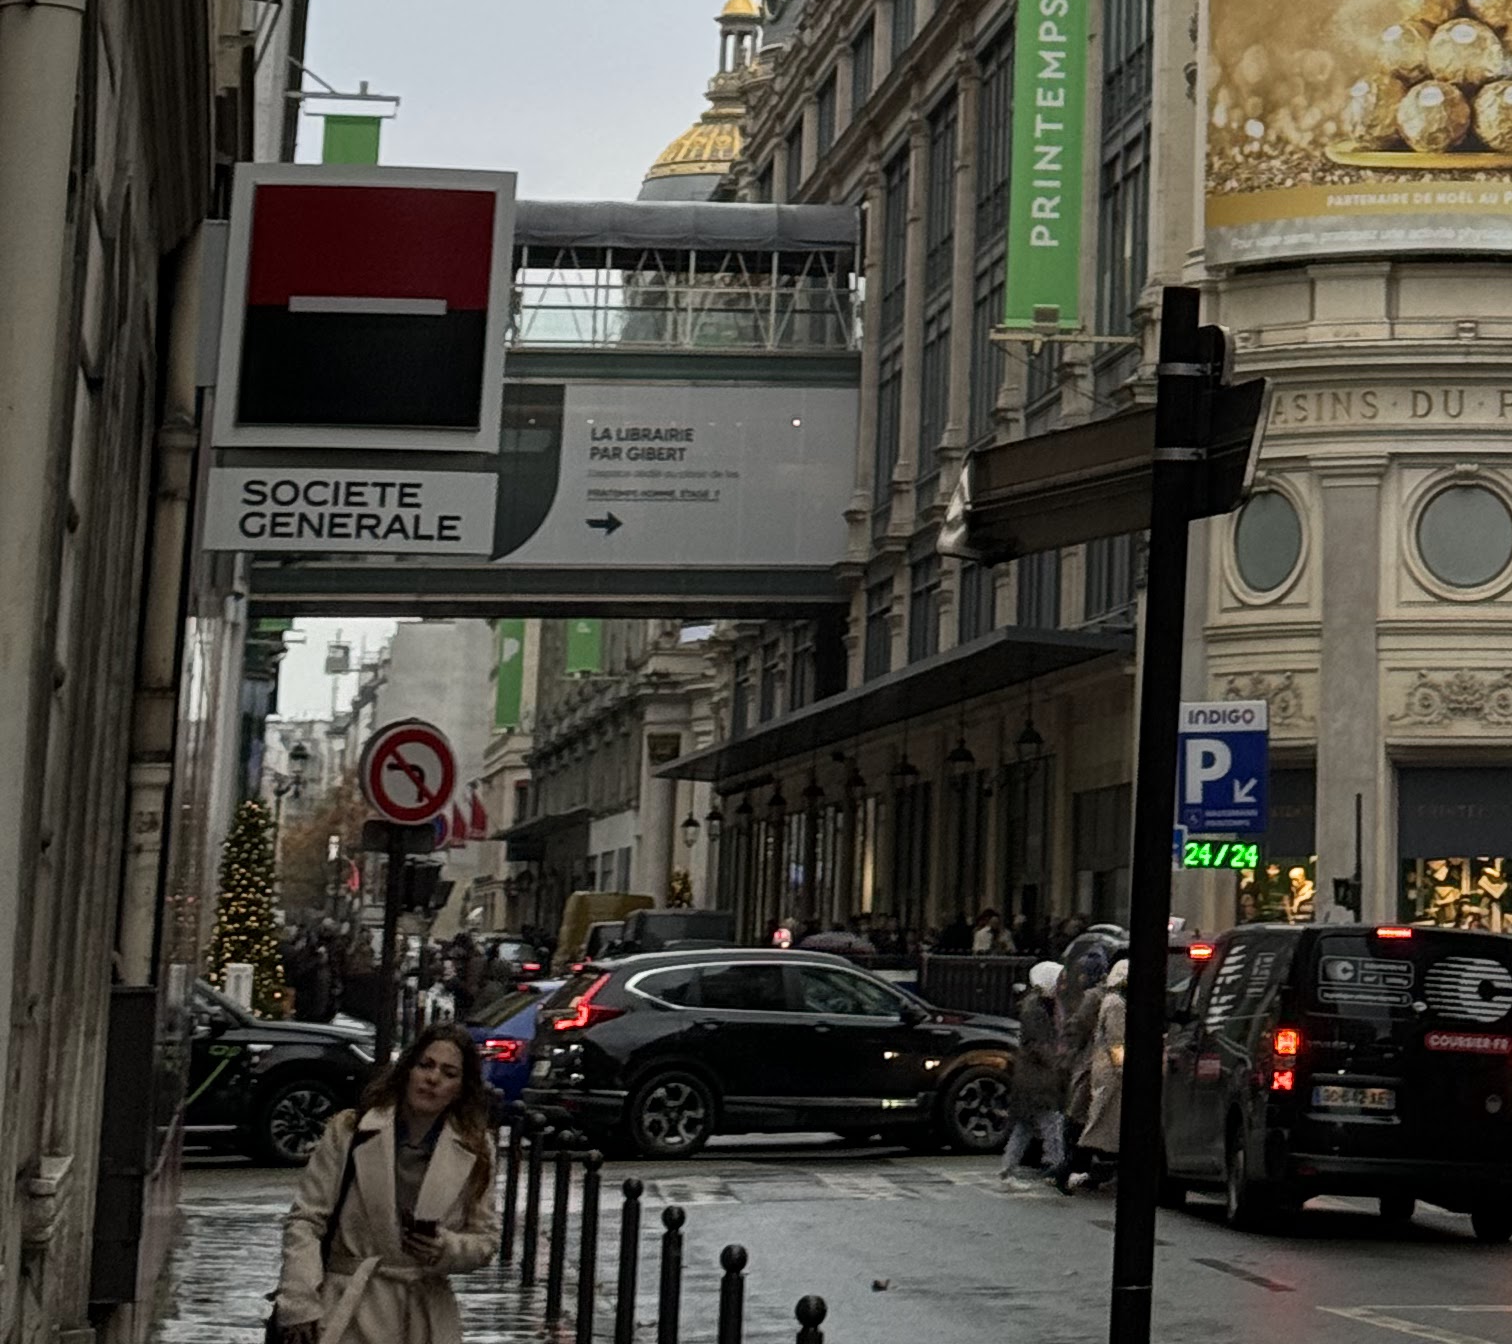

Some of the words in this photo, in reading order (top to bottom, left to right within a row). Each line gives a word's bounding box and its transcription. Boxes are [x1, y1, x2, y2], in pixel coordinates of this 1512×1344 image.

[1327, 192, 1409, 207] PARTENAIRE
[1413, 193, 1432, 205] DE
[1269, 390, 1380, 425] ASINS
[1409, 389, 1465, 419] DU
[590, 427, 612, 442] LA
[616, 427, 695, 442] LIBRAIRIE
[589, 446, 623, 461] PAR
[625, 446, 688, 461] GIBERT
[242, 480, 423, 508] SOCIETE
[239, 511, 462, 541] GENERALE
[1188, 708, 1255, 725] INDIGO
[1184, 738, 1233, 805] P
[1183, 842, 1259, 868] 24/24
